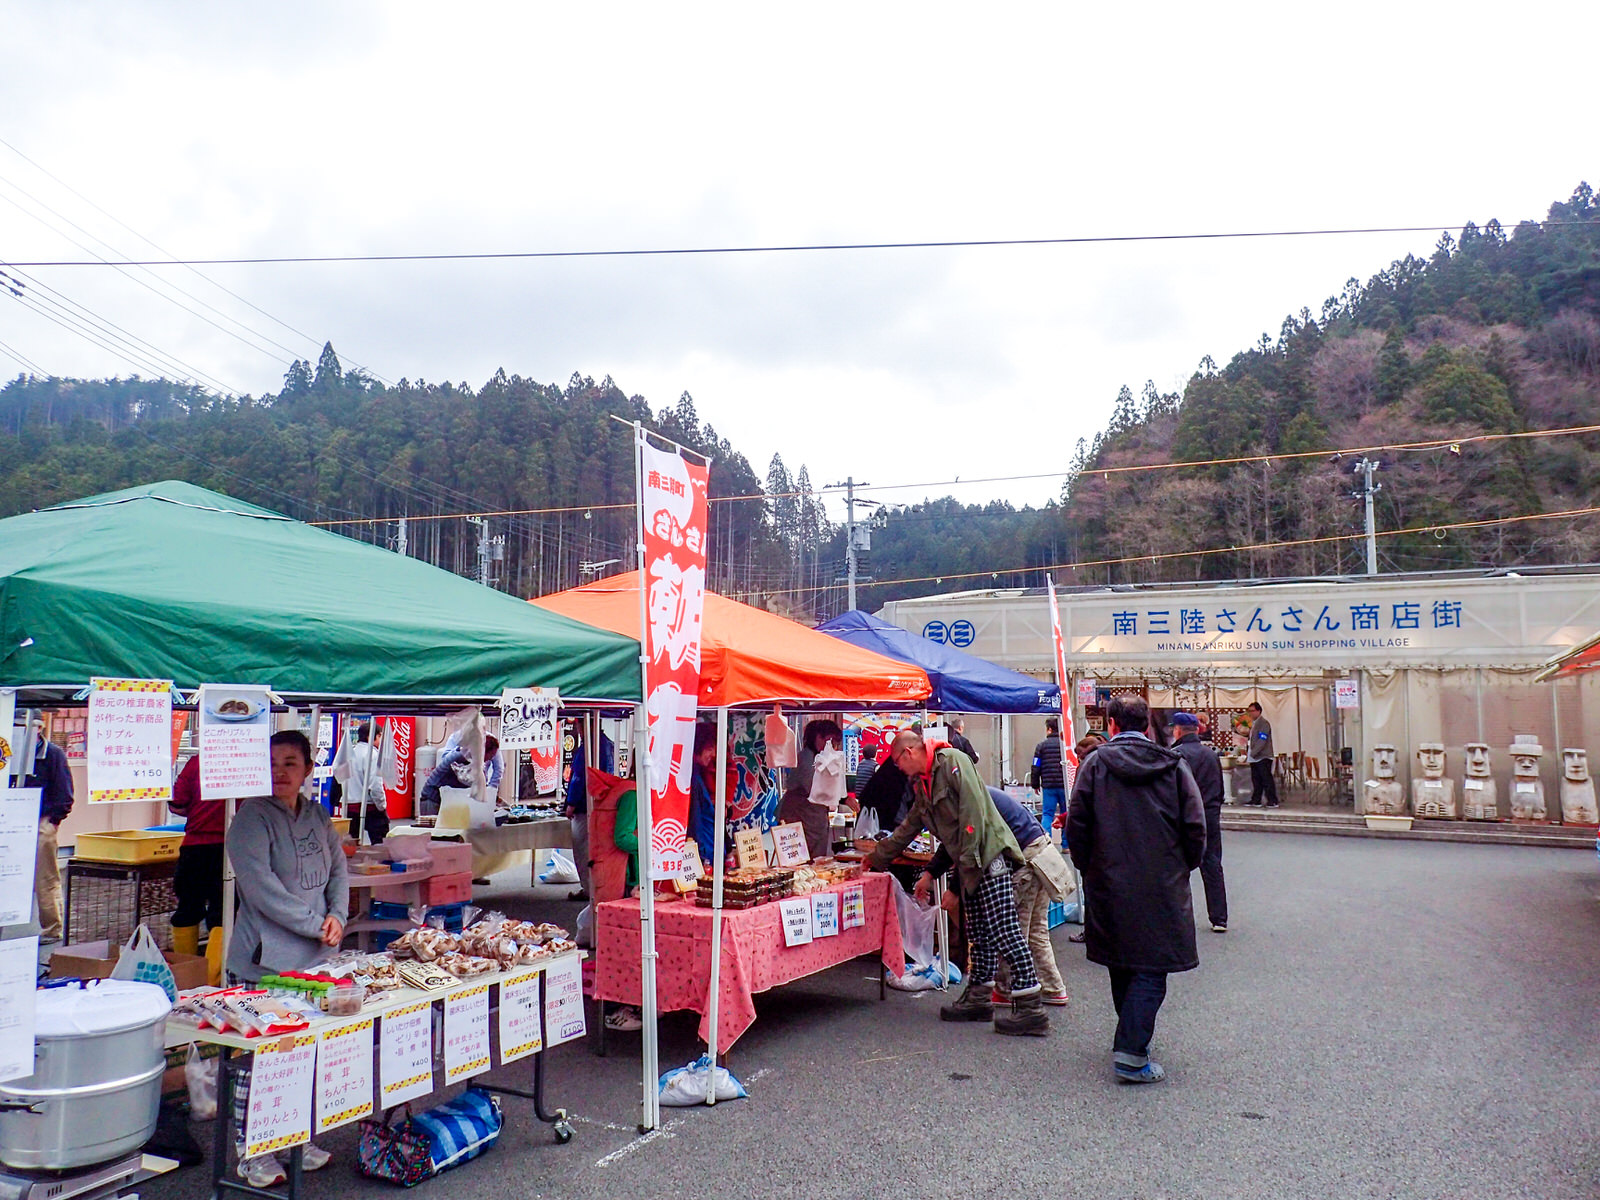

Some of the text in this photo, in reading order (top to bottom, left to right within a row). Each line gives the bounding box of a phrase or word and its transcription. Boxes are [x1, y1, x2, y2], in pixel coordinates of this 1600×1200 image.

[648, 470, 686, 498] 南三陸町
[1112, 600, 1462, 636] 南三陸さんさん商店街
[1157, 638, 1409, 651] MINAMISANRIKU SUN SUN SHOPPING VILLAGE
[94, 698, 165, 709] 地元の椎茸農家
[94, 713, 164, 724] が作った新商品
[97, 730, 134, 739] トリプル
[133, 769, 162, 777] ¥150
[257, 1050, 311, 1070] さんさん商店街
[412, 1057, 429, 1068] ¥400
[324, 1066, 350, 1083] 椎茸
[324, 1077, 365, 1099] ちんすこう
[253, 1096, 282, 1113] 椎茸
[324, 1097, 346, 1109] ¥100
[251, 1109, 298, 1130] かりんとう
[251, 1129, 275, 1141] ¥350
